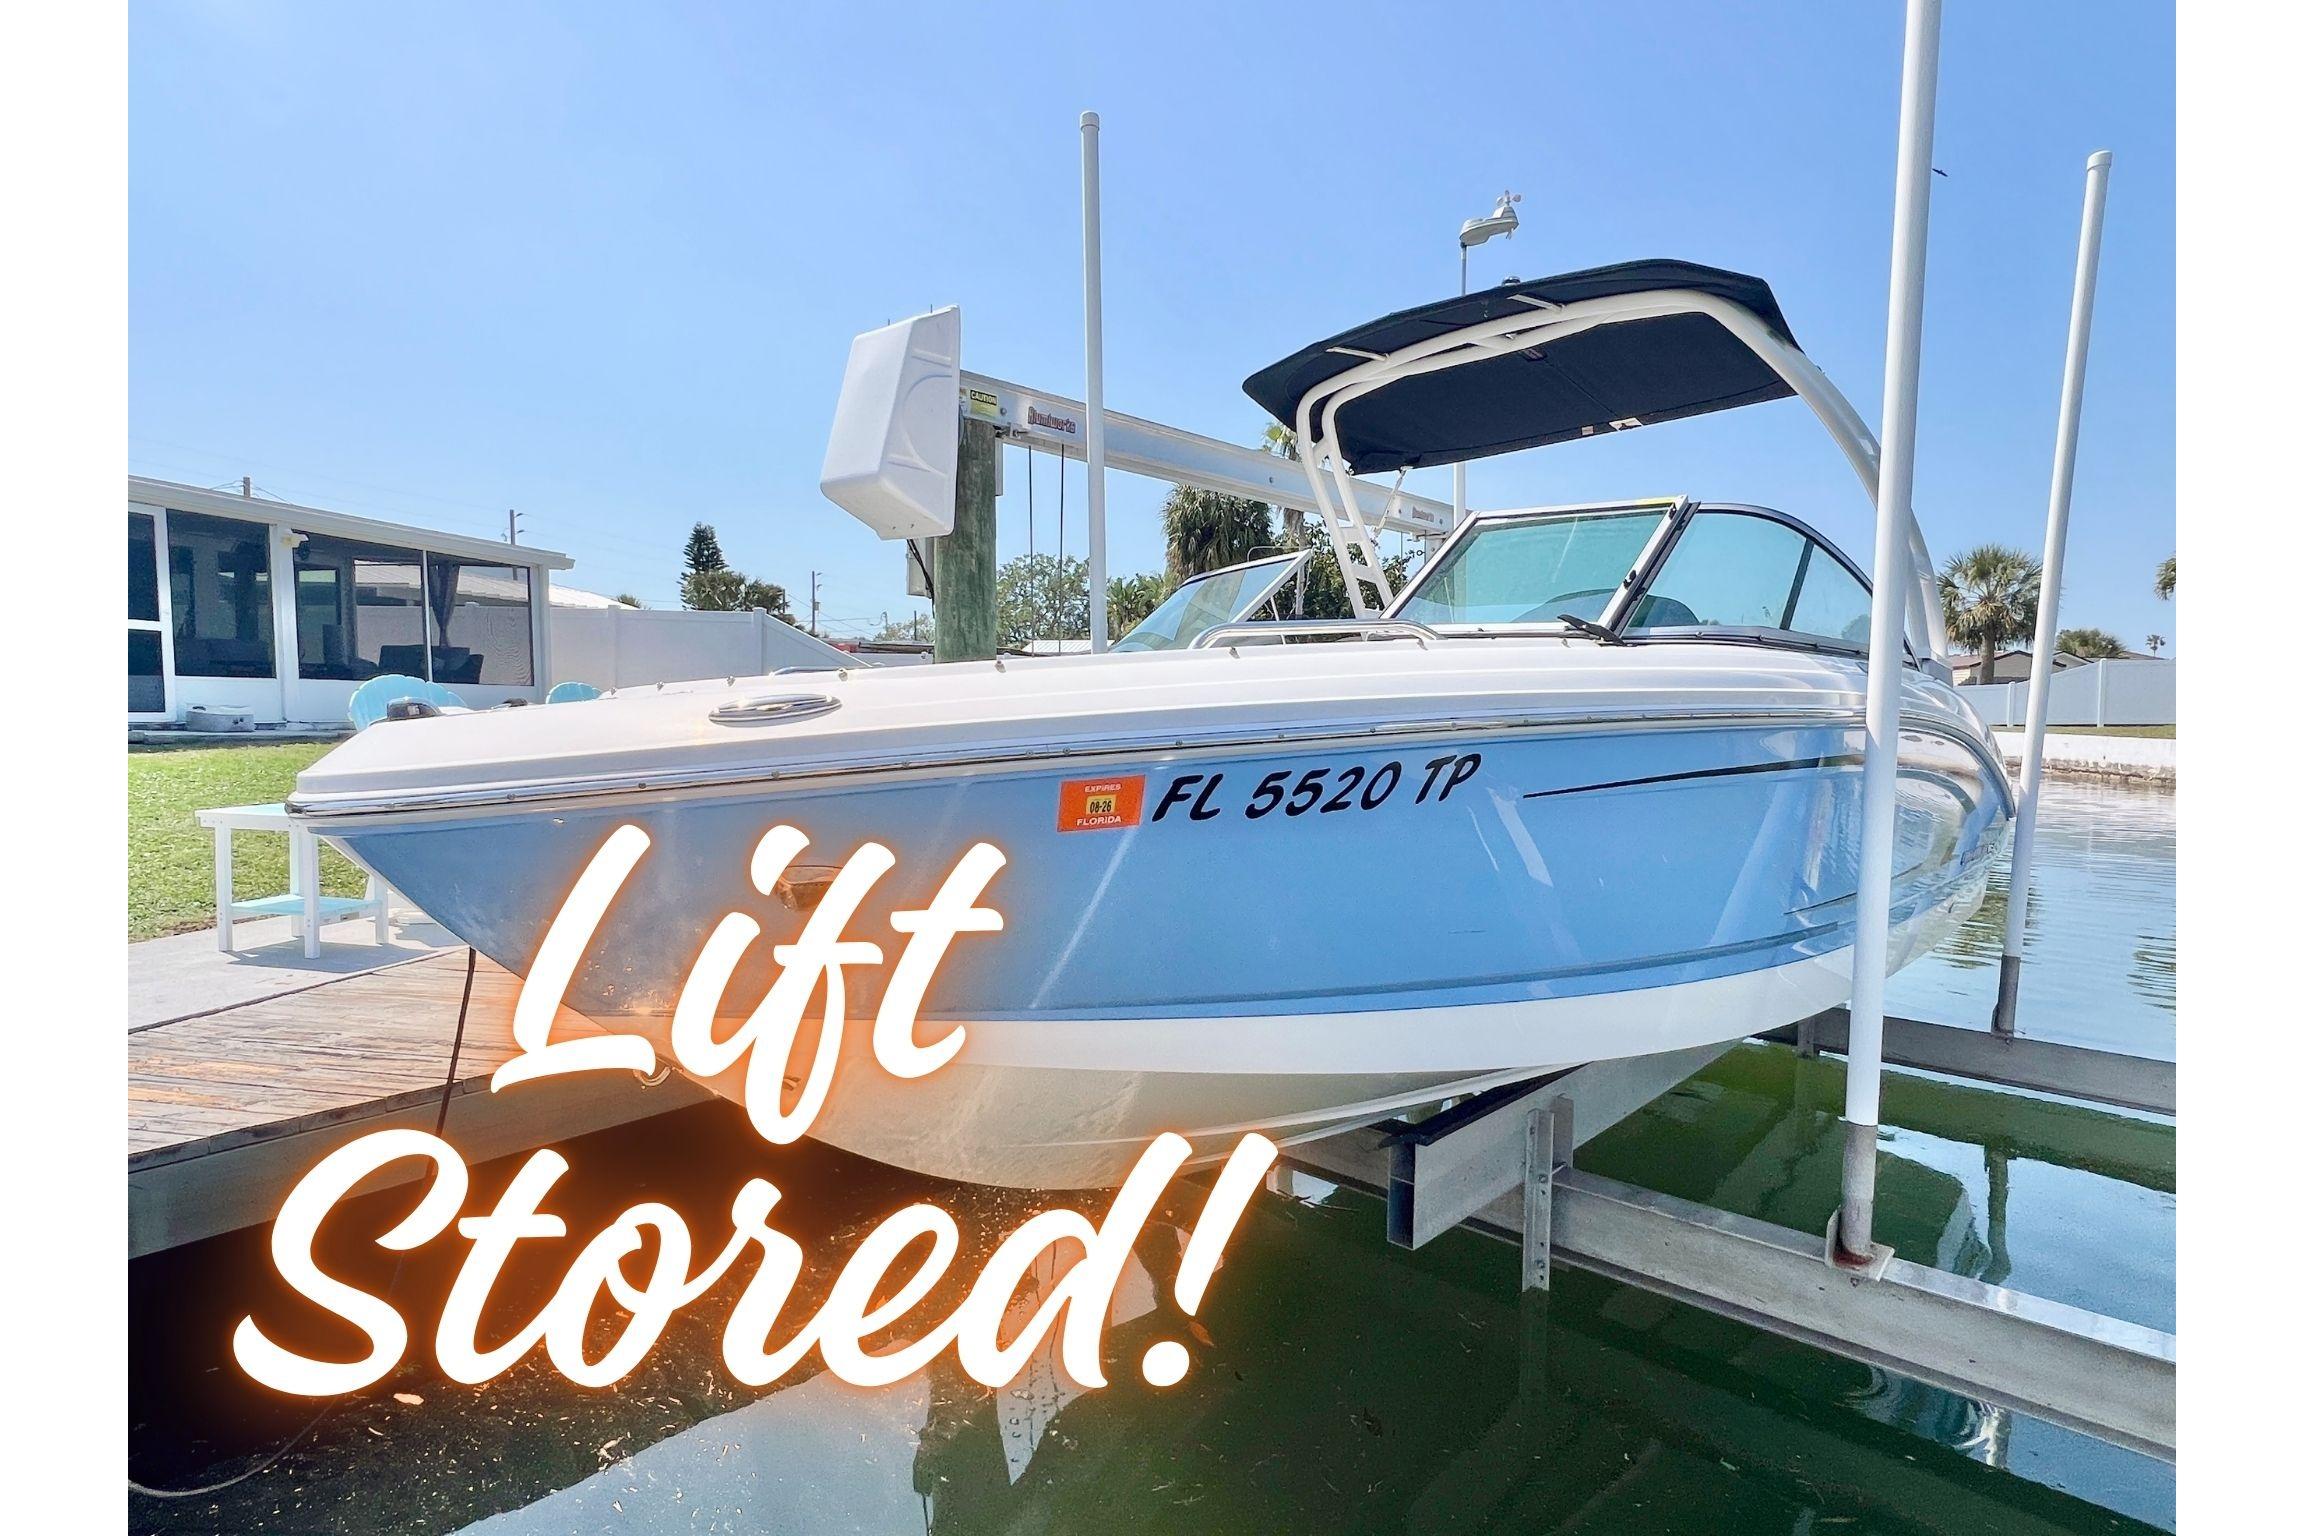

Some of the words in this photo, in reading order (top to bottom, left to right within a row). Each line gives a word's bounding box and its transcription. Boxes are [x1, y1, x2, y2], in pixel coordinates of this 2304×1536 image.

[971, 391, 997, 405] CAUTION
[1084, 783, 1122, 793] EXPIRES
[1151, 773, 1224, 822] FL
[1244, 761, 1402, 819] 5520
[1415, 753, 1482, 804] TP
[1089, 800, 1112, 814] 08-26
[1076, 815, 1122, 826] FLORIDA
